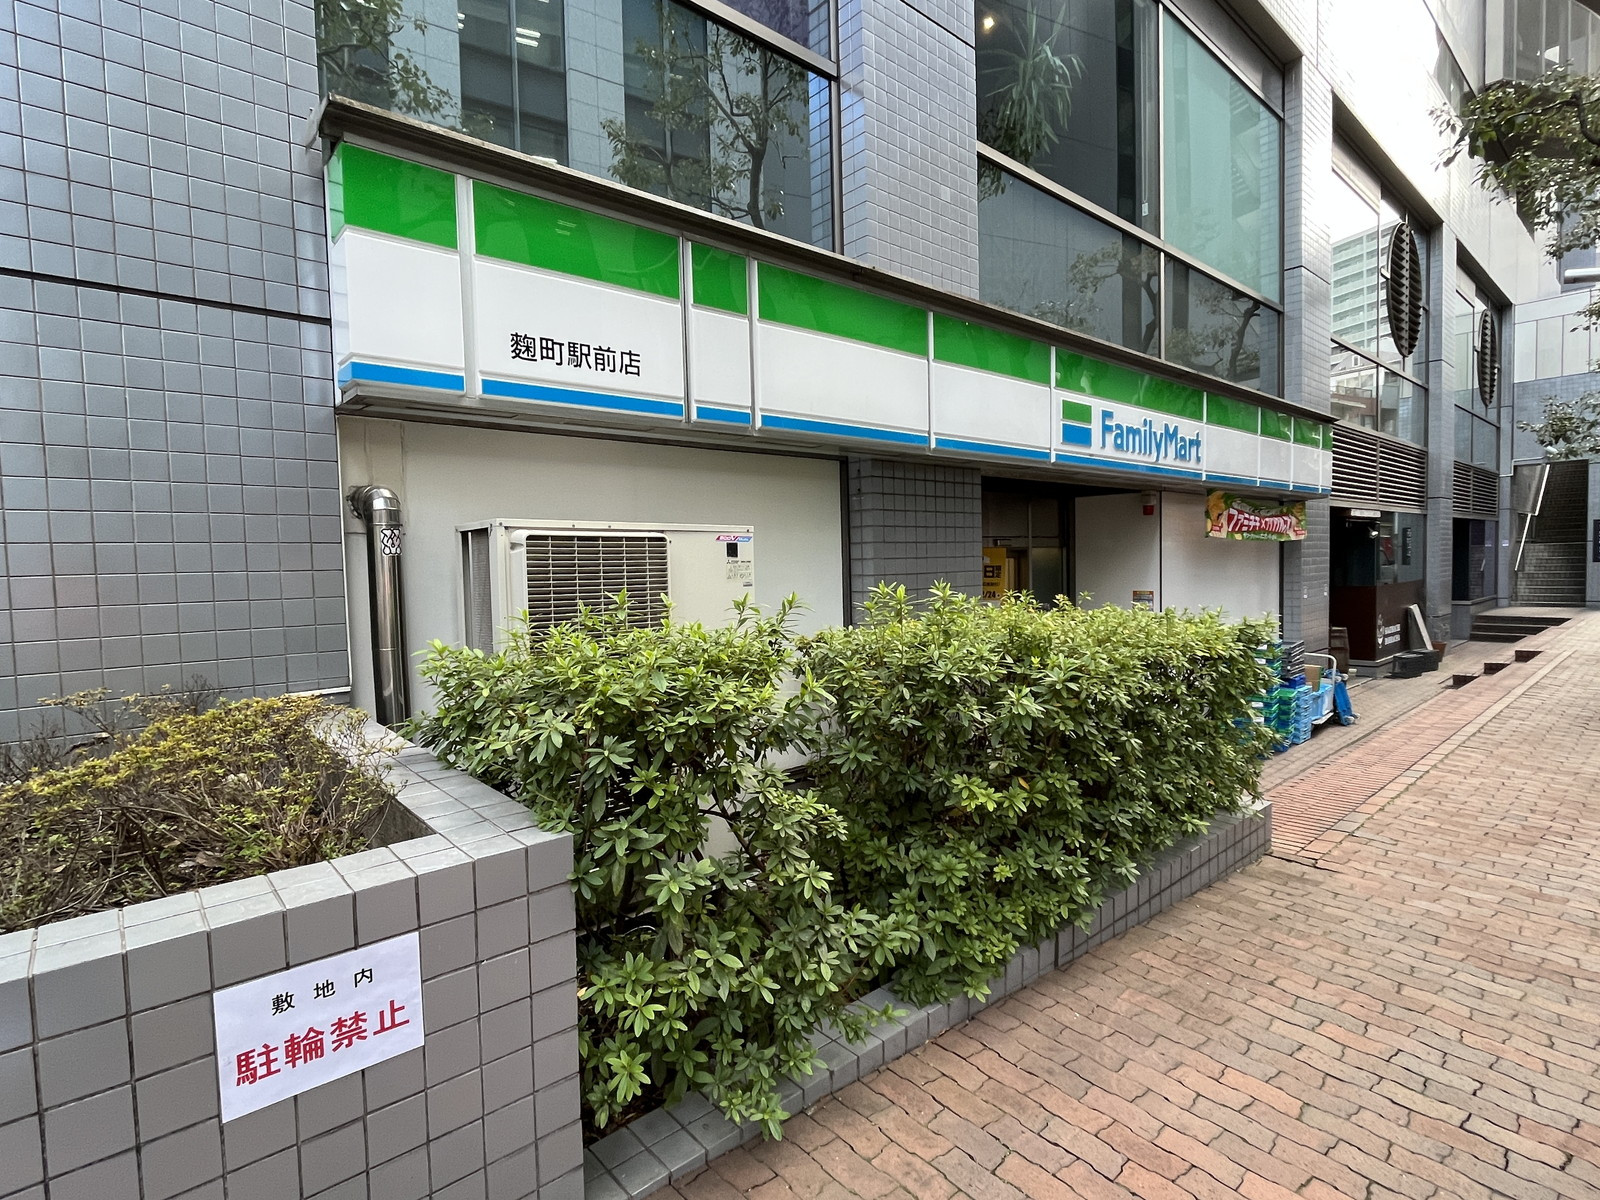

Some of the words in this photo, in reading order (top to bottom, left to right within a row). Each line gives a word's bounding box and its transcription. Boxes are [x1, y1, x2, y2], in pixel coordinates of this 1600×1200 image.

[1100, 409, 1202, 465] FamilyMart
[235, 999, 411, 1087] 駐輪禁止
